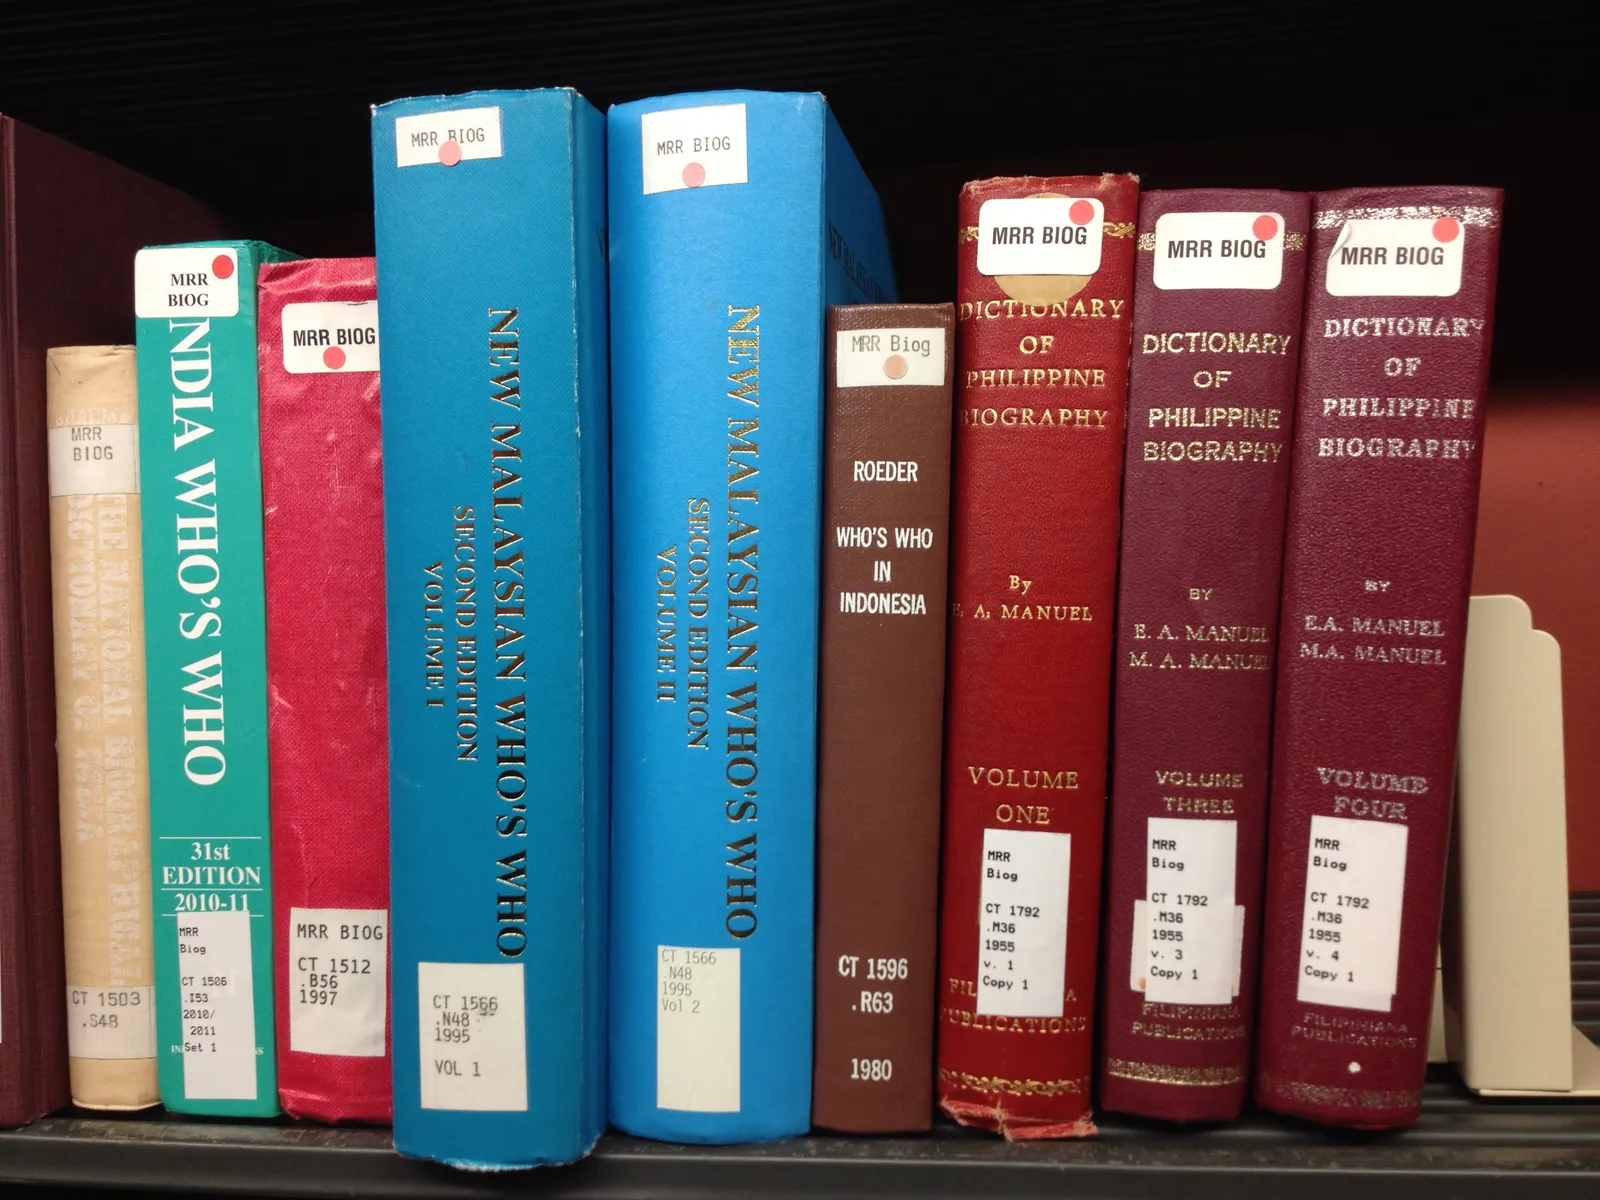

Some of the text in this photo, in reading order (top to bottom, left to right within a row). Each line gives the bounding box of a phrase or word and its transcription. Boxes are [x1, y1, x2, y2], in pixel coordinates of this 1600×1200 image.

[411, 128, 486, 147] MRR BIOG
[656, 136, 731, 156] MRR BIOG
[992, 226, 1088, 245] MRR BIOG
[1167, 239, 1266, 258] MRR BIOG
[1340, 247, 1444, 265] MRR BIOG
[170, 273, 208, 287] MRR
[167, 293, 209, 308] BIOG
[959, 298, 1124, 320] DICTIONARY
[1323, 317, 1485, 338] DICTIONARY
[293, 327, 376, 347] MRR BIOG
[852, 335, 931, 357] MRR Biog
[1019, 335, 1054, 354] OF
[1142, 331, 1291, 355] DICTIONARY
[1383, 357, 1421, 377] OF
[169, 317, 215, 452] NDIA
[966, 369, 1105, 389] PHILIPPINE
[1192, 370, 1232, 388] OF
[1322, 397, 1476, 419] PHILIPPINE
[1148, 407, 1281, 429] PHILIPPINE
[71, 427, 103, 442] MRR
[72, 445, 114, 462] BIOG
[1143, 440, 1282, 463] BIOGRAPHY
[1317, 437, 1476, 460] BIOGRAPHY
[853, 460, 918, 482] ROEDER
[836, 526, 933, 549] WHO'S WHO
[873, 560, 891, 582] IN
[1009, 575, 1032, 595] By
[1188, 588, 1214, 600] BY
[840, 592, 927, 615] INDONESIA
[1001, 604, 1093, 621] MANUEL
[656, 545, 677, 703] VOLUME II
[687, 497, 710, 751] SECOND EDITION
[725, 304, 760, 940] NEW MALAYSIAN WHO'S WHO
[1352, 617, 1445, 637] MANUEL
[424, 560, 445, 708] VOLUME I
[453, 505, 478, 762] SECOND EDITION
[487, 307, 528, 958] NEW MALAYSIAN WHO'S WHO
[1134, 623, 1269, 643] E. A. MANUEL
[1129, 651, 1269, 670] M. A. MANUEL
[1354, 646, 1447, 665] MANUEL
[181, 650, 226, 786] WHO
[968, 766, 1079, 789] VOLUME
[1155, 769, 1244, 788] VOLUME
[1316, 767, 1429, 795] VOLUME
[995, 803, 1051, 825] ONE
[1164, 796, 1235, 814] THREE
[1333, 796, 1409, 820] FOUR
[190, 842, 231, 861] 31st
[1152, 839, 1176, 851] MRR
[1314, 838, 1340, 851] MRR
[987, 851, 1011, 863] MRR
[1152, 857, 1184, 871] Biog
[1313, 856, 1347, 871] Biog
[162, 866, 261, 885] EDITION
[987, 868, 1018, 882] Biog
[175, 893, 250, 911] 2010-11
[1151, 893, 1208, 907] CT 1792
[1310, 892, 1370, 909] CT 1792
[986, 903, 1040, 918] CT 1792
[1153, 912, 1183, 924] .M36
[1311, 911, 1343, 924] .M36
[179, 927, 199, 937] MRR
[297, 924, 384, 941] MRR BIOG
[986, 922, 1016, 934] .M36
[1152, 929, 1183, 941] 1955
[1308, 928, 1341, 943] 1955
[180, 944, 207, 956] Biog
[985, 940, 1015, 953] 1955
[1151, 950, 1183, 960] v. 3
[1306, 949, 1340, 961] v. 4
[298, 957, 372, 975] CT 1512
[661, 949, 717, 965] CT 1566
[984, 960, 1014, 971] v. 1
[663, 967, 693, 980] .N48
[838, 954, 908, 980] CT 1596
[1150, 966, 1199, 981] Copy 1
[1304, 965, 1354, 982] Copy 1
[181, 977, 196, 987] CT
[300, 974, 339, 990] .B56
[661, 982, 693, 997] 1995
[983, 975, 1014, 990] Copy
[1022, 979, 1029, 990] 1
[72, 991, 141, 1007] CT 1503
[300, 990, 338, 1006] 1997
[433, 994, 498, 1012] CT 1566
[661, 998, 700, 1014] Vol 2
[851, 991, 893, 1014] .R63
[81, 1013, 119, 1029] .S48
[183, 1009, 216, 1020] 2010/
[436, 1012, 470, 1027] .N48
[190, 1026, 217, 1036] 2011
[434, 1027, 470, 1043] 1995
[184, 1041, 204, 1053] Set
[210, 1041, 217, 1052] 1
[434, 1060, 482, 1077] VOL 1
[851, 1058, 892, 1081] 1980
